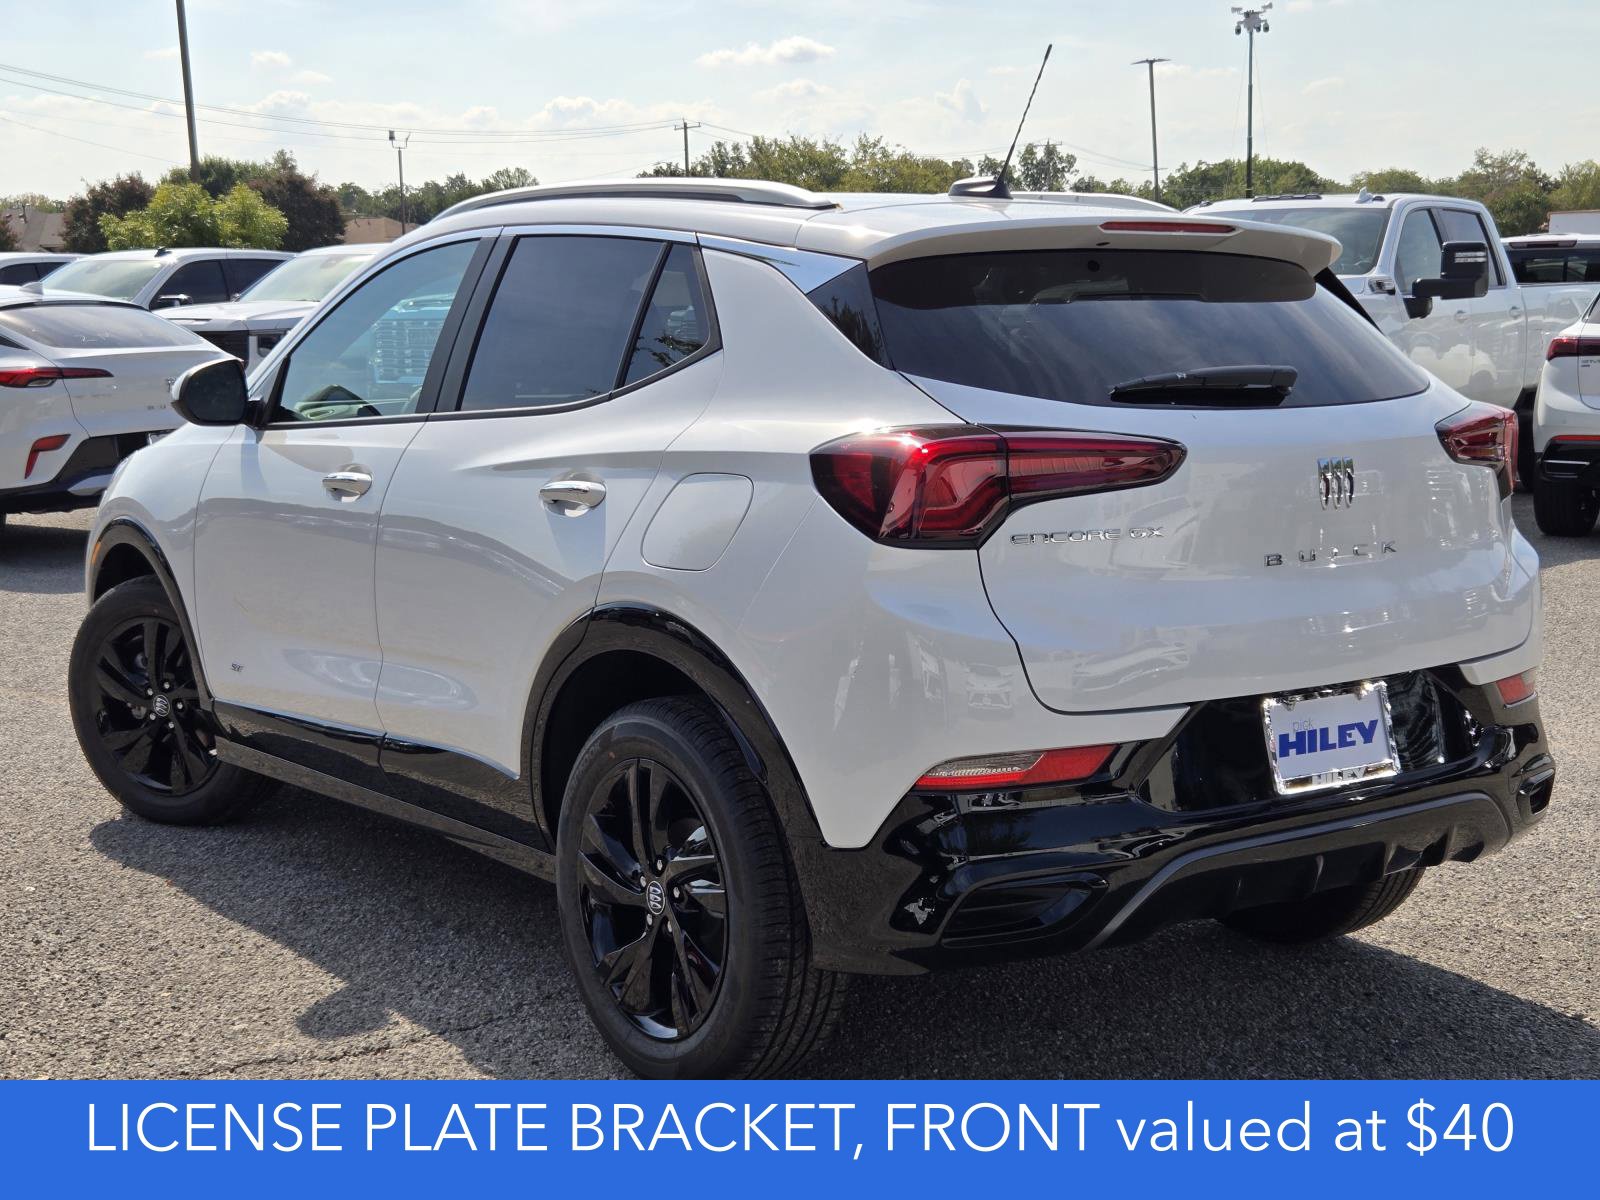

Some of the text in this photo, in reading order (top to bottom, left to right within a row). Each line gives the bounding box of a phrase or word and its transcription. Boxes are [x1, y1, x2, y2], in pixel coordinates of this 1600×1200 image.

[1010, 526, 1165, 545] ENCORE GX
[1265, 540, 1397, 567] BUICK
[1278, 719, 1379, 759] HILEY
